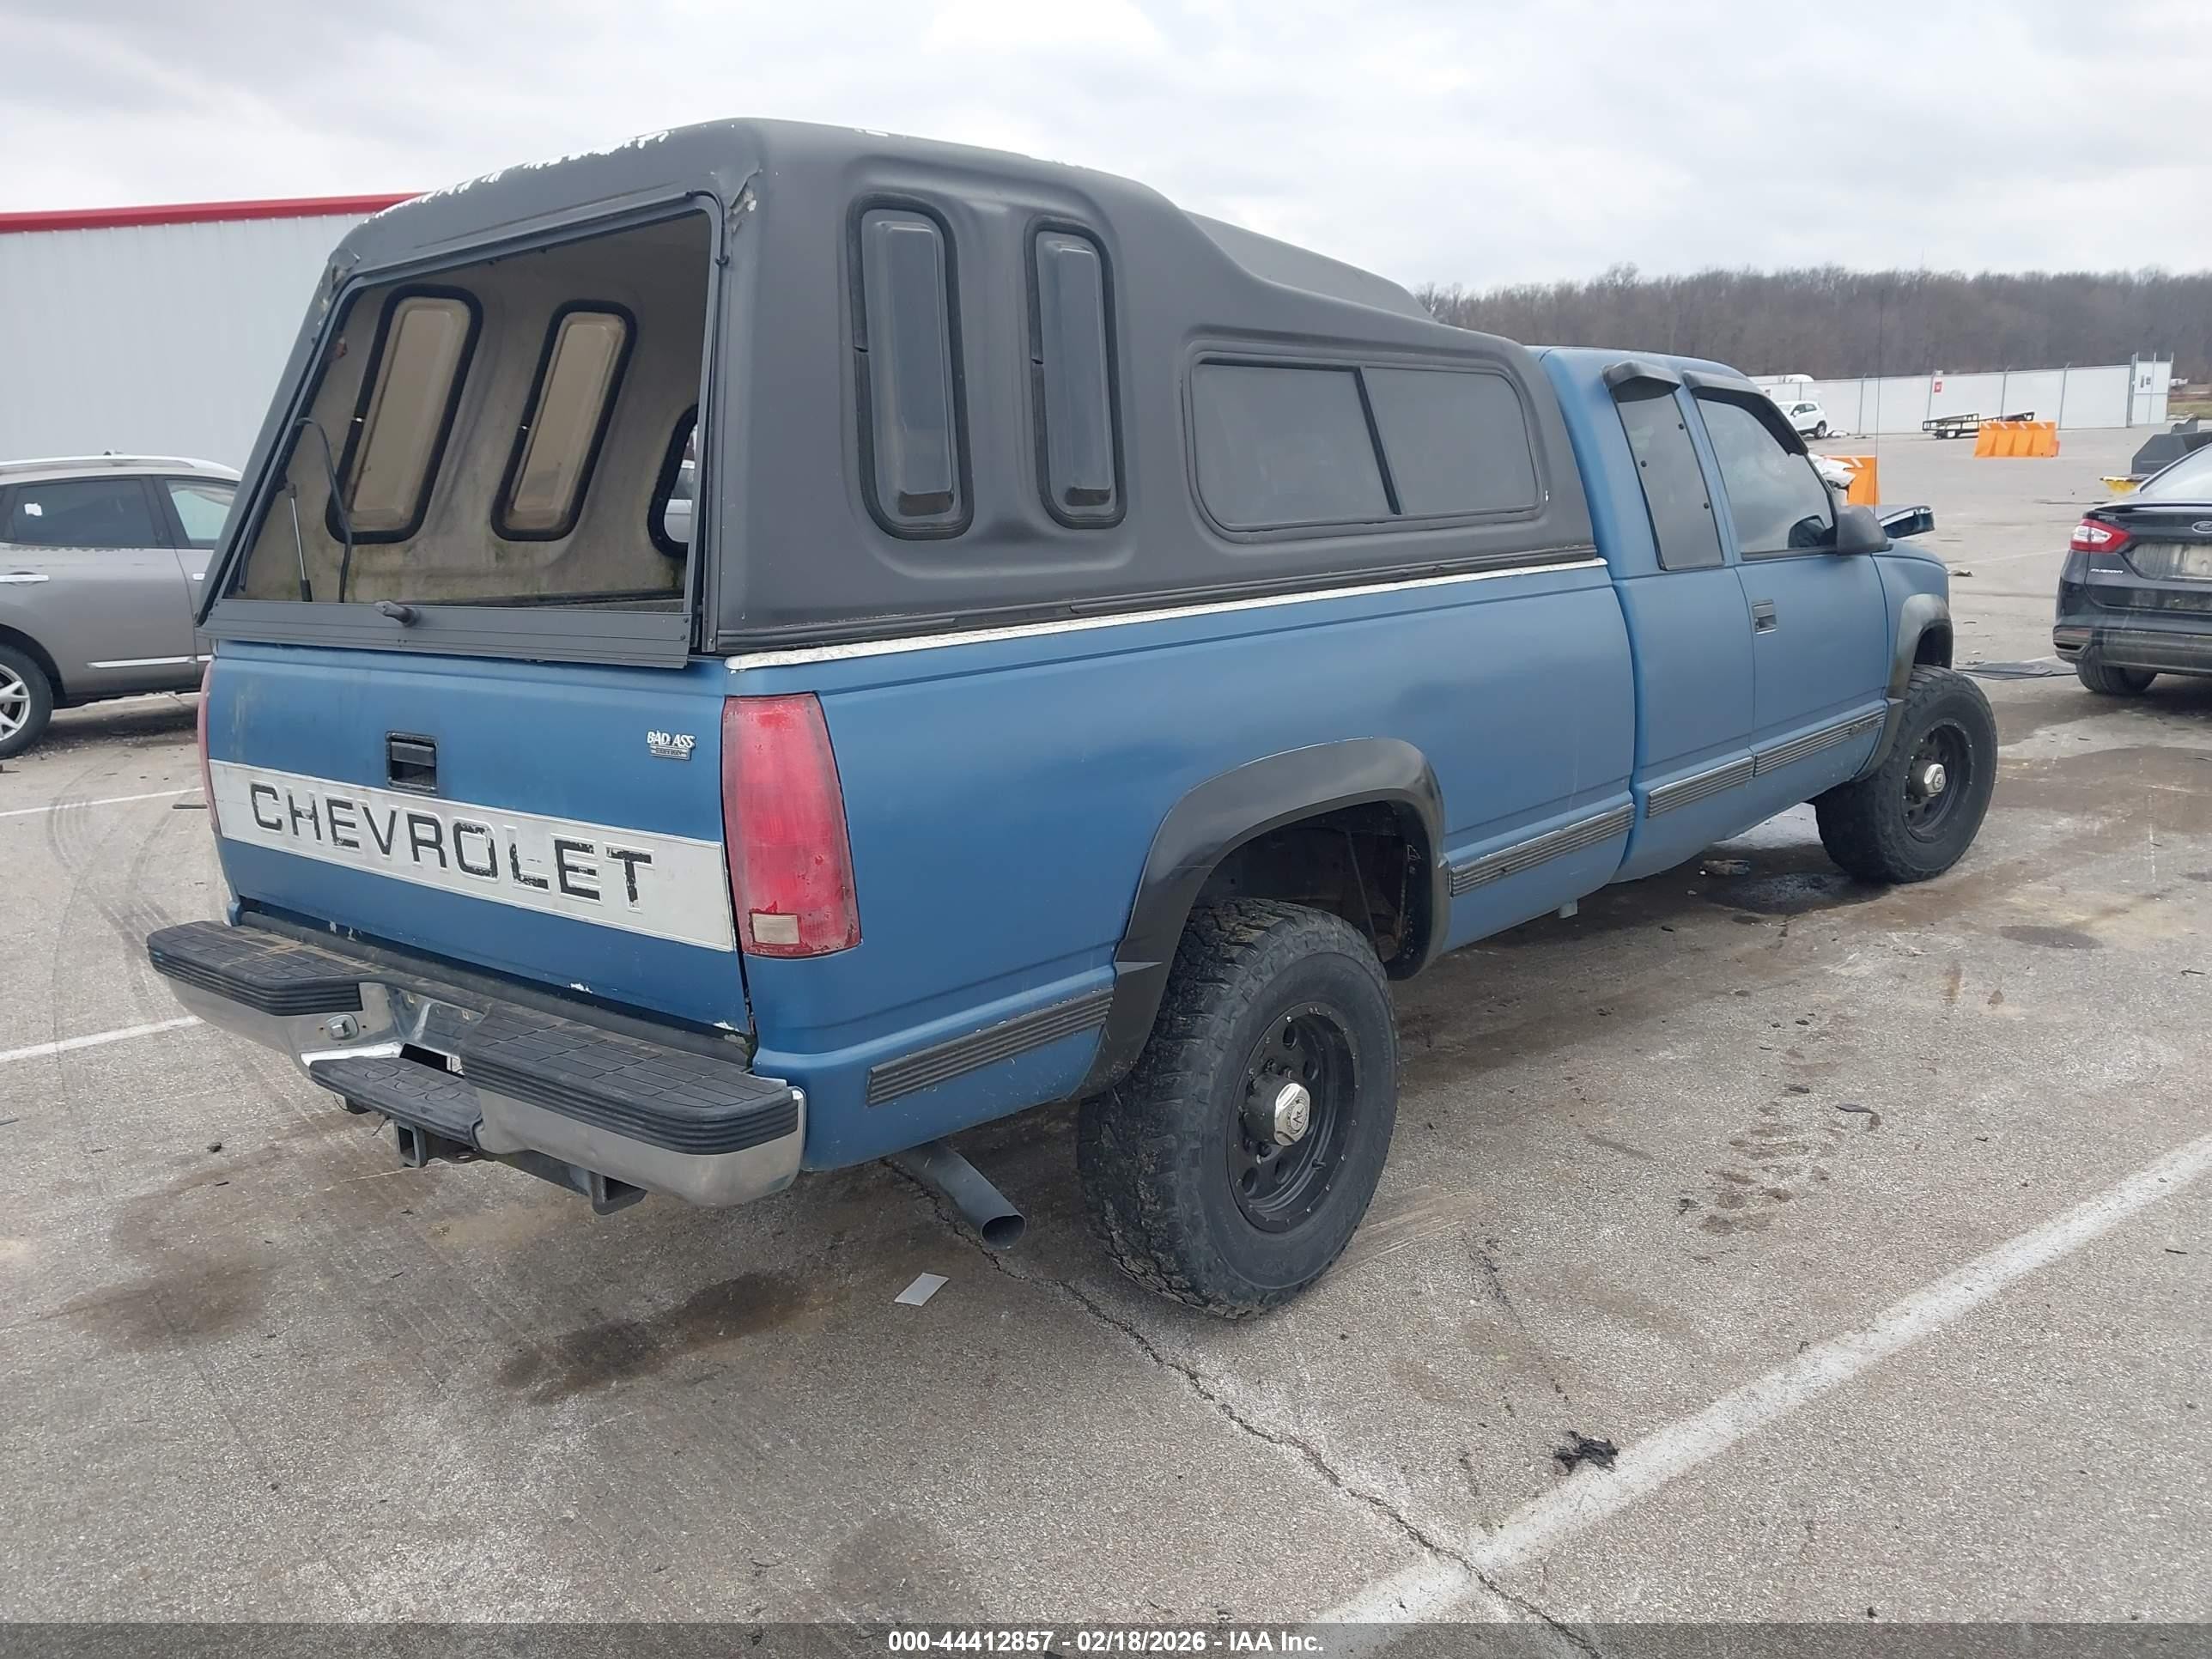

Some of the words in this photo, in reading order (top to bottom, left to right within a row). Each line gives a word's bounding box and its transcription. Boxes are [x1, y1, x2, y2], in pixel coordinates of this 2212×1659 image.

[647, 730, 671, 745] BAD
[672, 734, 696, 749] ASS
[250, 781, 653, 909] CHEVROLET
